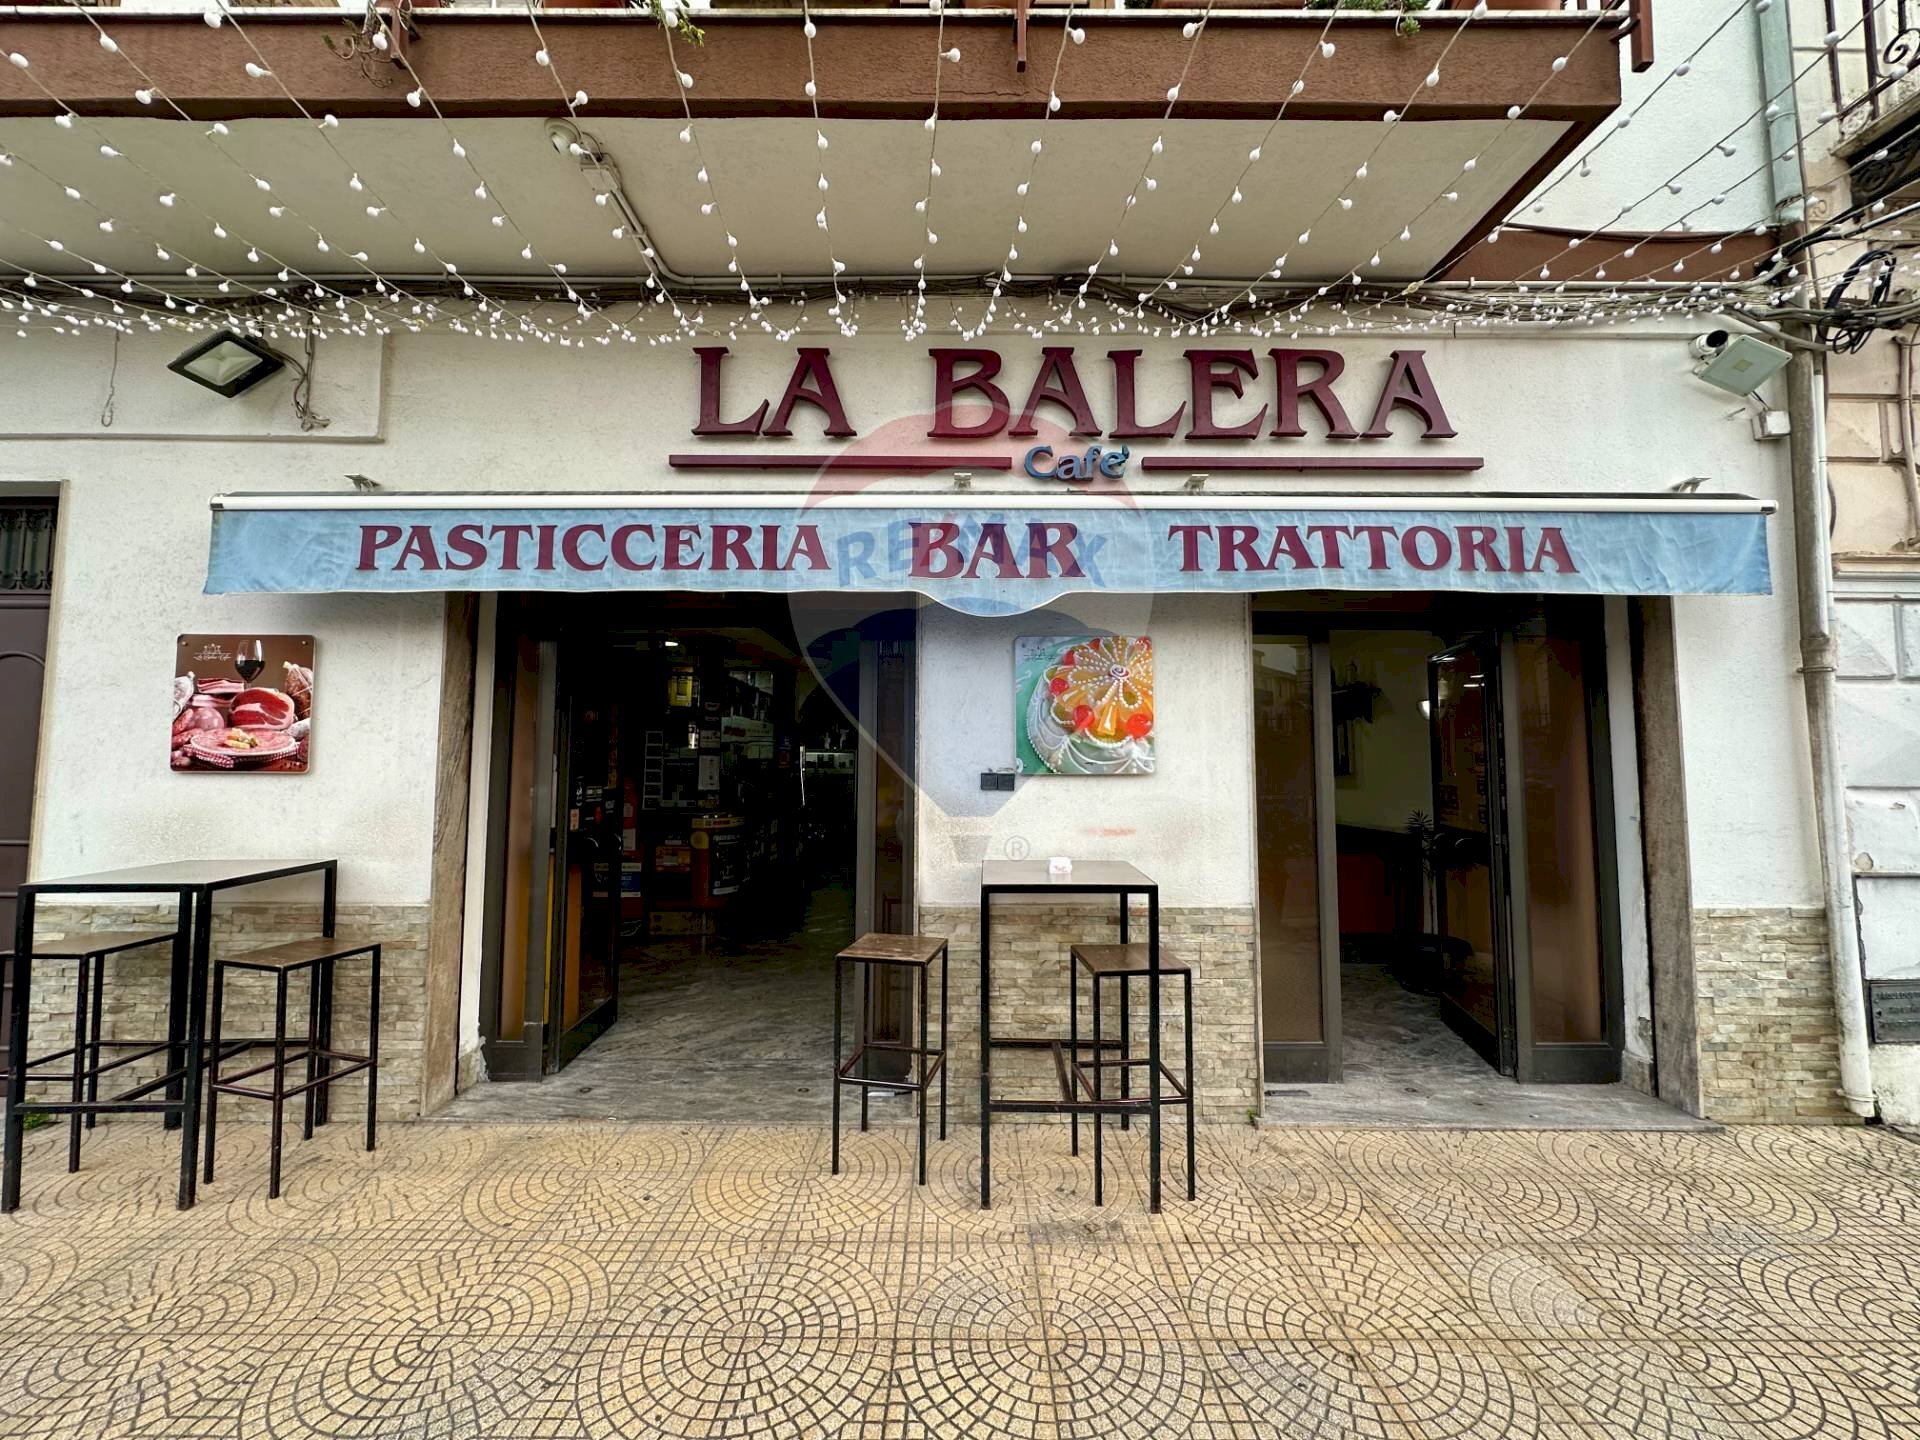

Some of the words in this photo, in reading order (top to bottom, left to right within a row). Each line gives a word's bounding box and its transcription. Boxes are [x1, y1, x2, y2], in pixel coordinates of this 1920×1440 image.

[691, 346, 856, 437] LA
[926, 346, 1459, 441] BALERA
[358, 523, 831, 571] PASTICCERIA
[908, 521, 1086, 579] BAR
[1167, 525, 1579, 574] TRATTORIA
